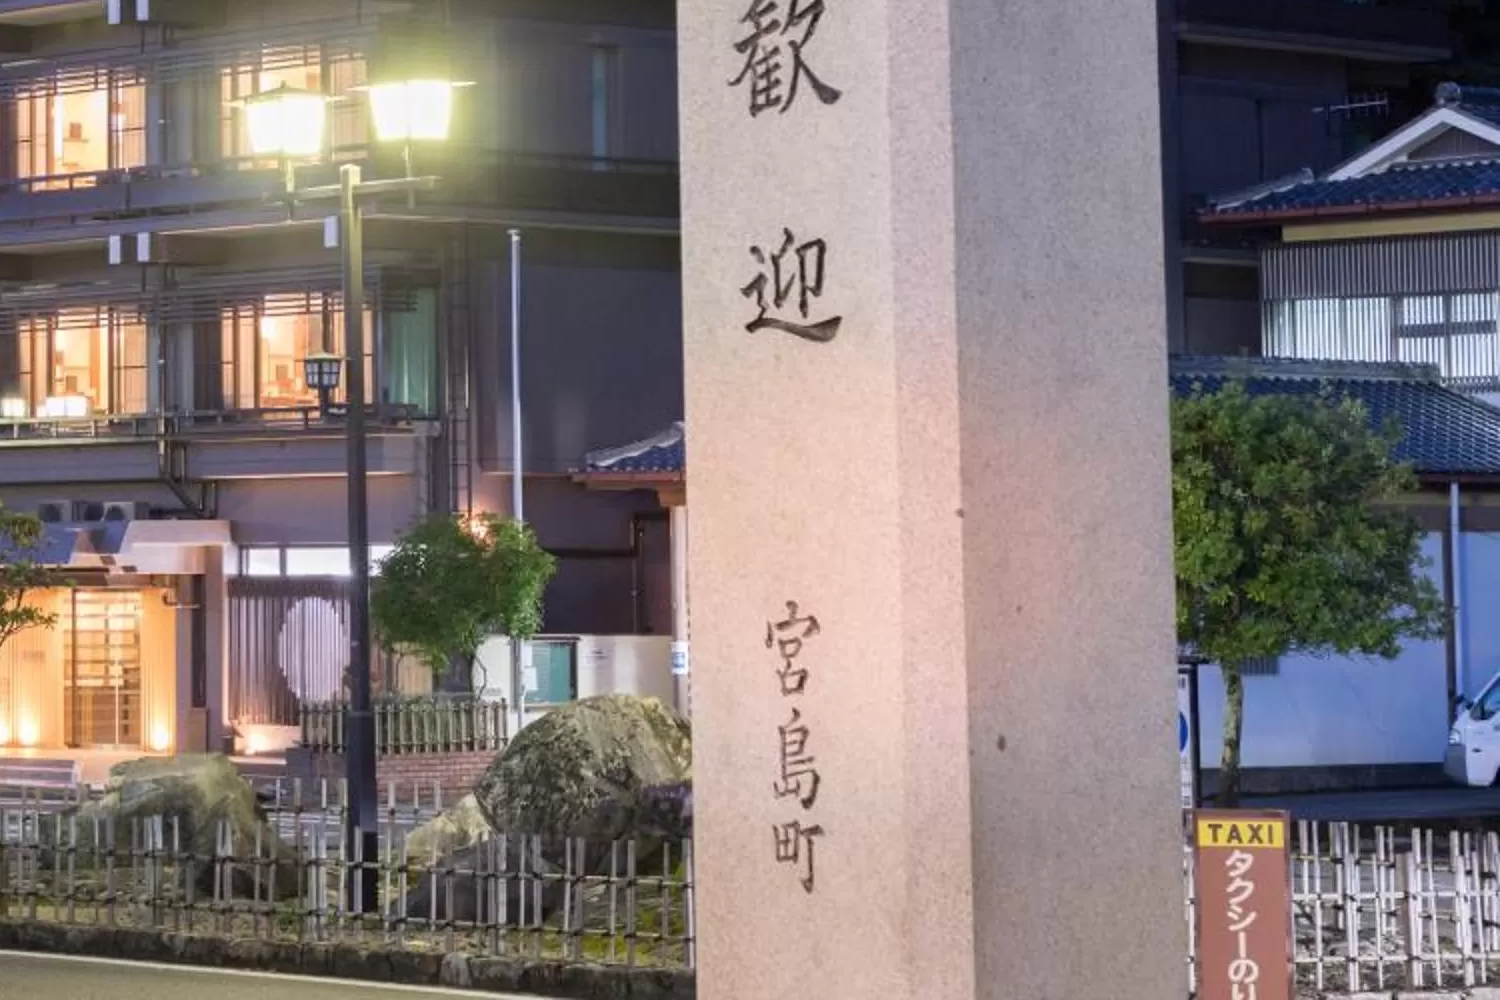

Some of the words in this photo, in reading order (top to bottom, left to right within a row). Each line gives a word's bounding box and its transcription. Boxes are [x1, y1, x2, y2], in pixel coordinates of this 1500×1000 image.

[764, 599, 825, 894] 宮島町
[1207, 823, 1275, 844] TAXI
